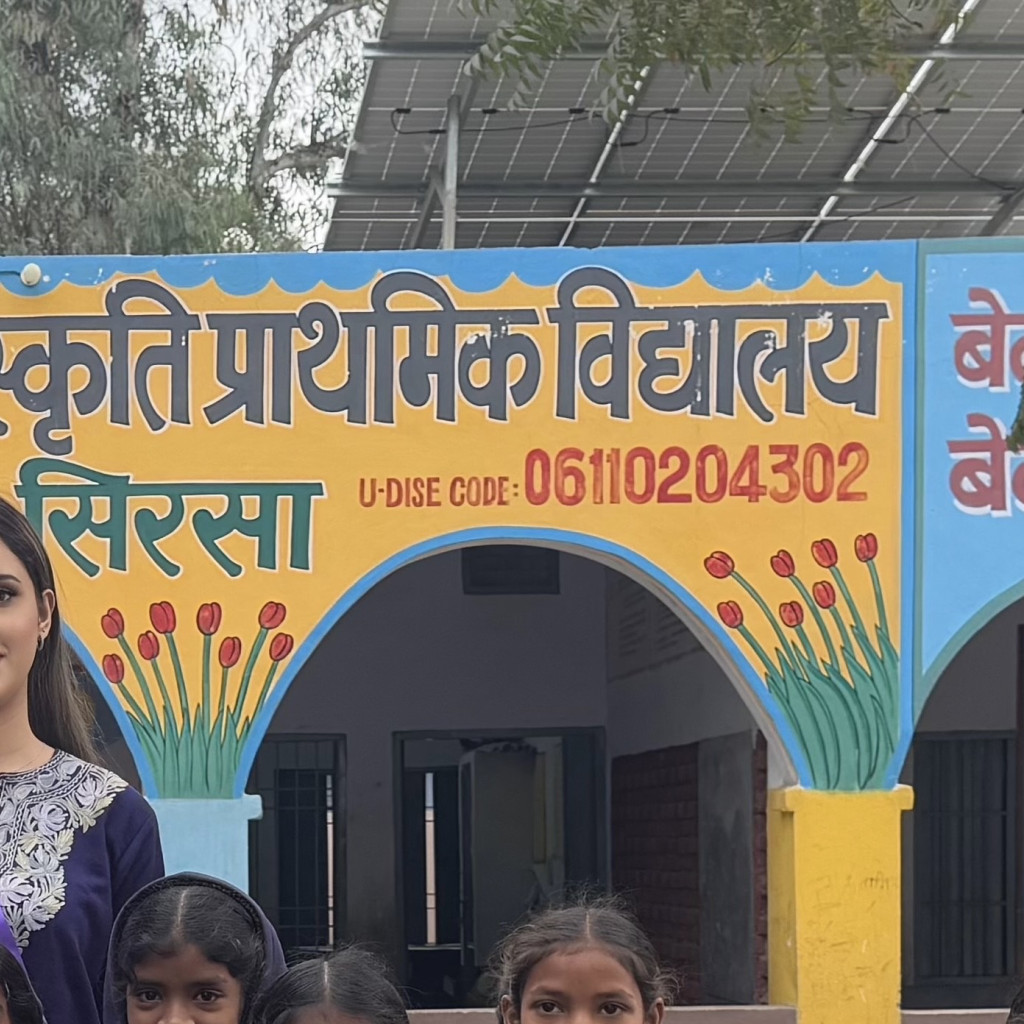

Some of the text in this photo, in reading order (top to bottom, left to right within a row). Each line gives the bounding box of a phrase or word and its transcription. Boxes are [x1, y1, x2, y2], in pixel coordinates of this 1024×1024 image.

[206, 270, 541, 428] प्राथमिक
[548, 266, 890, 424] विद्यालय
[14, 457, 325, 578] सिरसा
[358, 477, 442, 509] U-DISE
[523, 441, 871, 507] 06110204302
